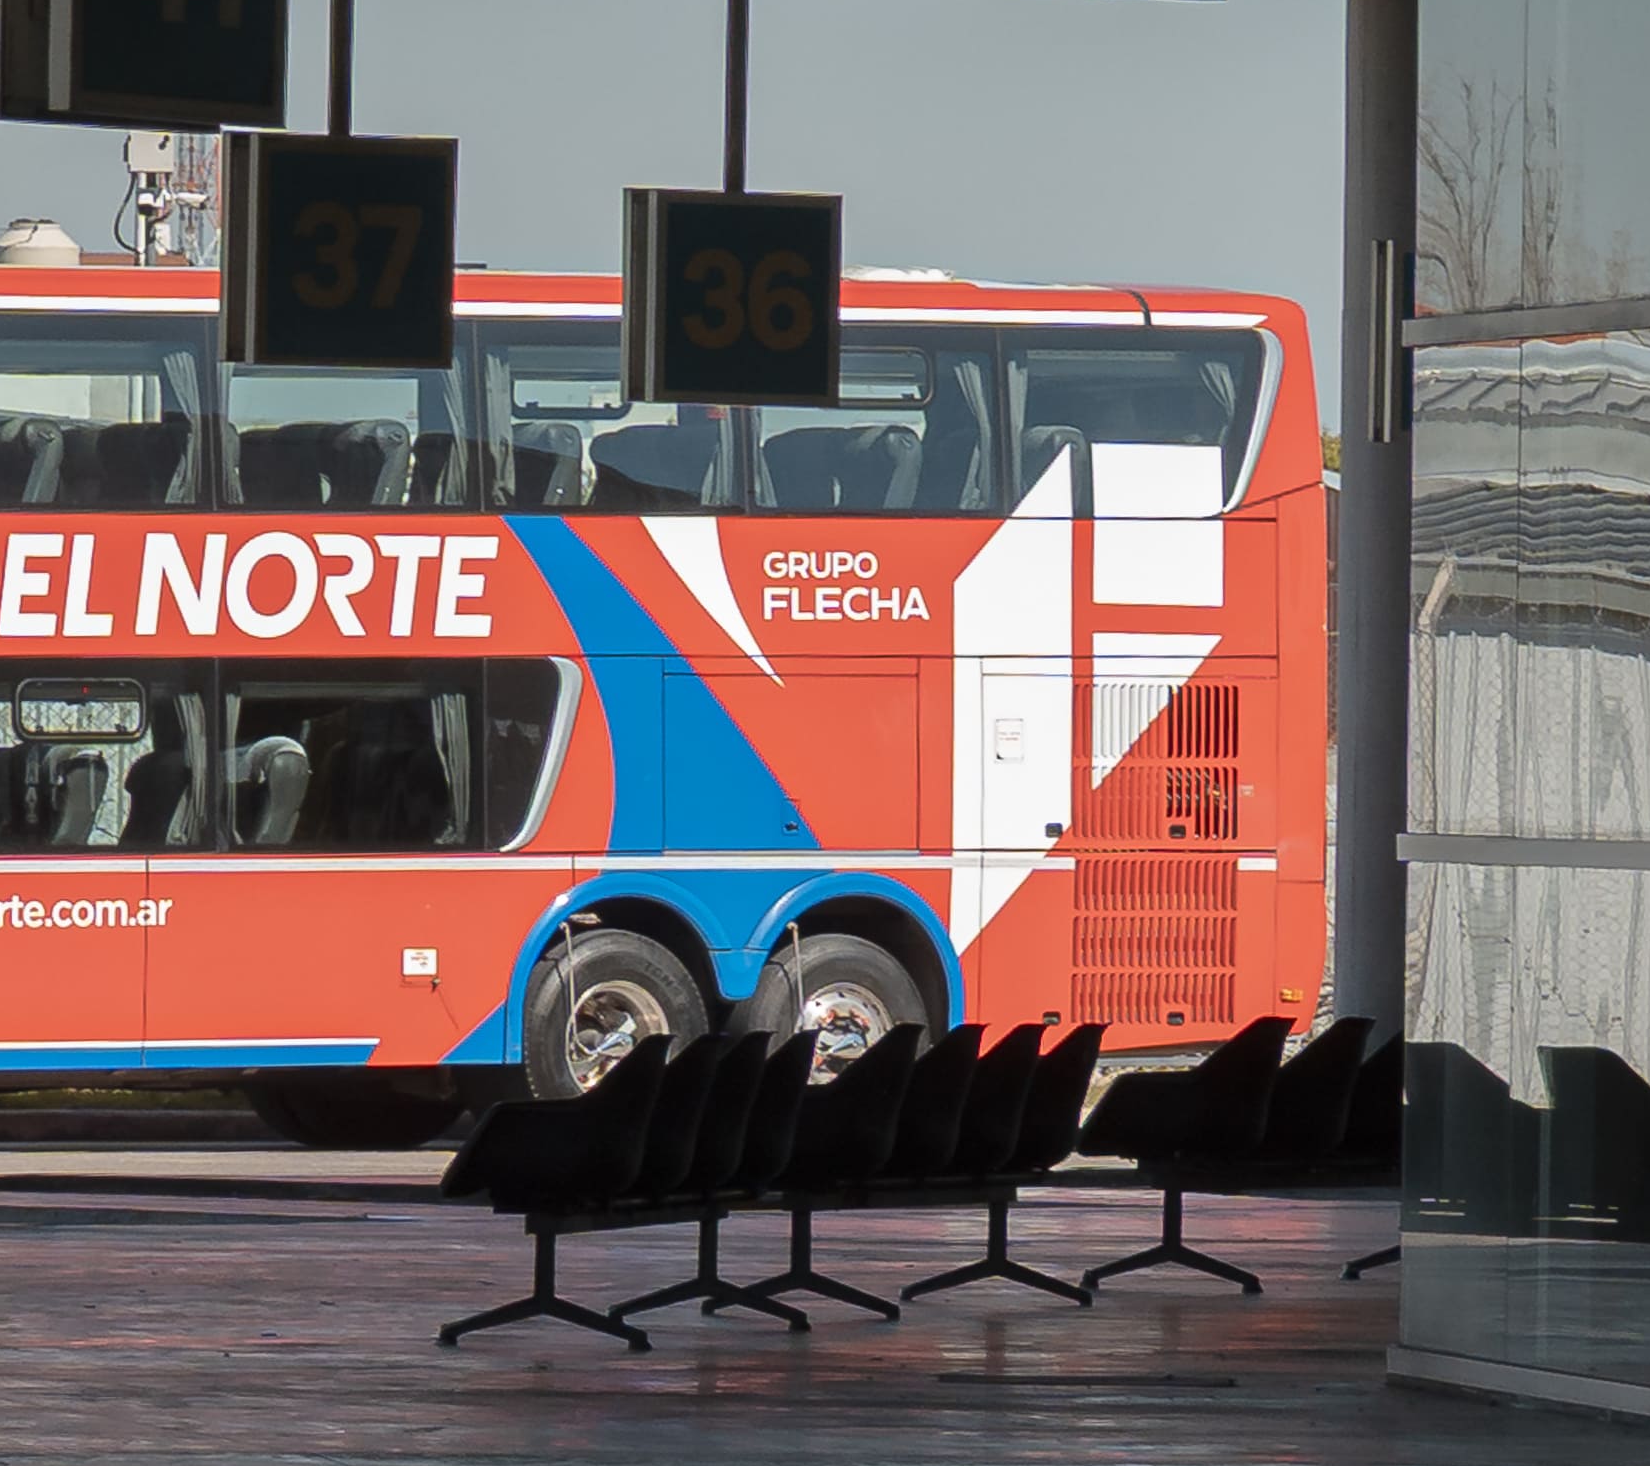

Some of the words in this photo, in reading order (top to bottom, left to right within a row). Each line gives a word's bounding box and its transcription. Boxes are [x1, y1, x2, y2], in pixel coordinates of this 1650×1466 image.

[291, 201, 423, 310] 37
[682, 248, 815, 352] 36
[135, 531, 499, 639] NORTE
[763, 551, 878, 580] GRUPO
[763, 586, 930, 622] FLECHA
